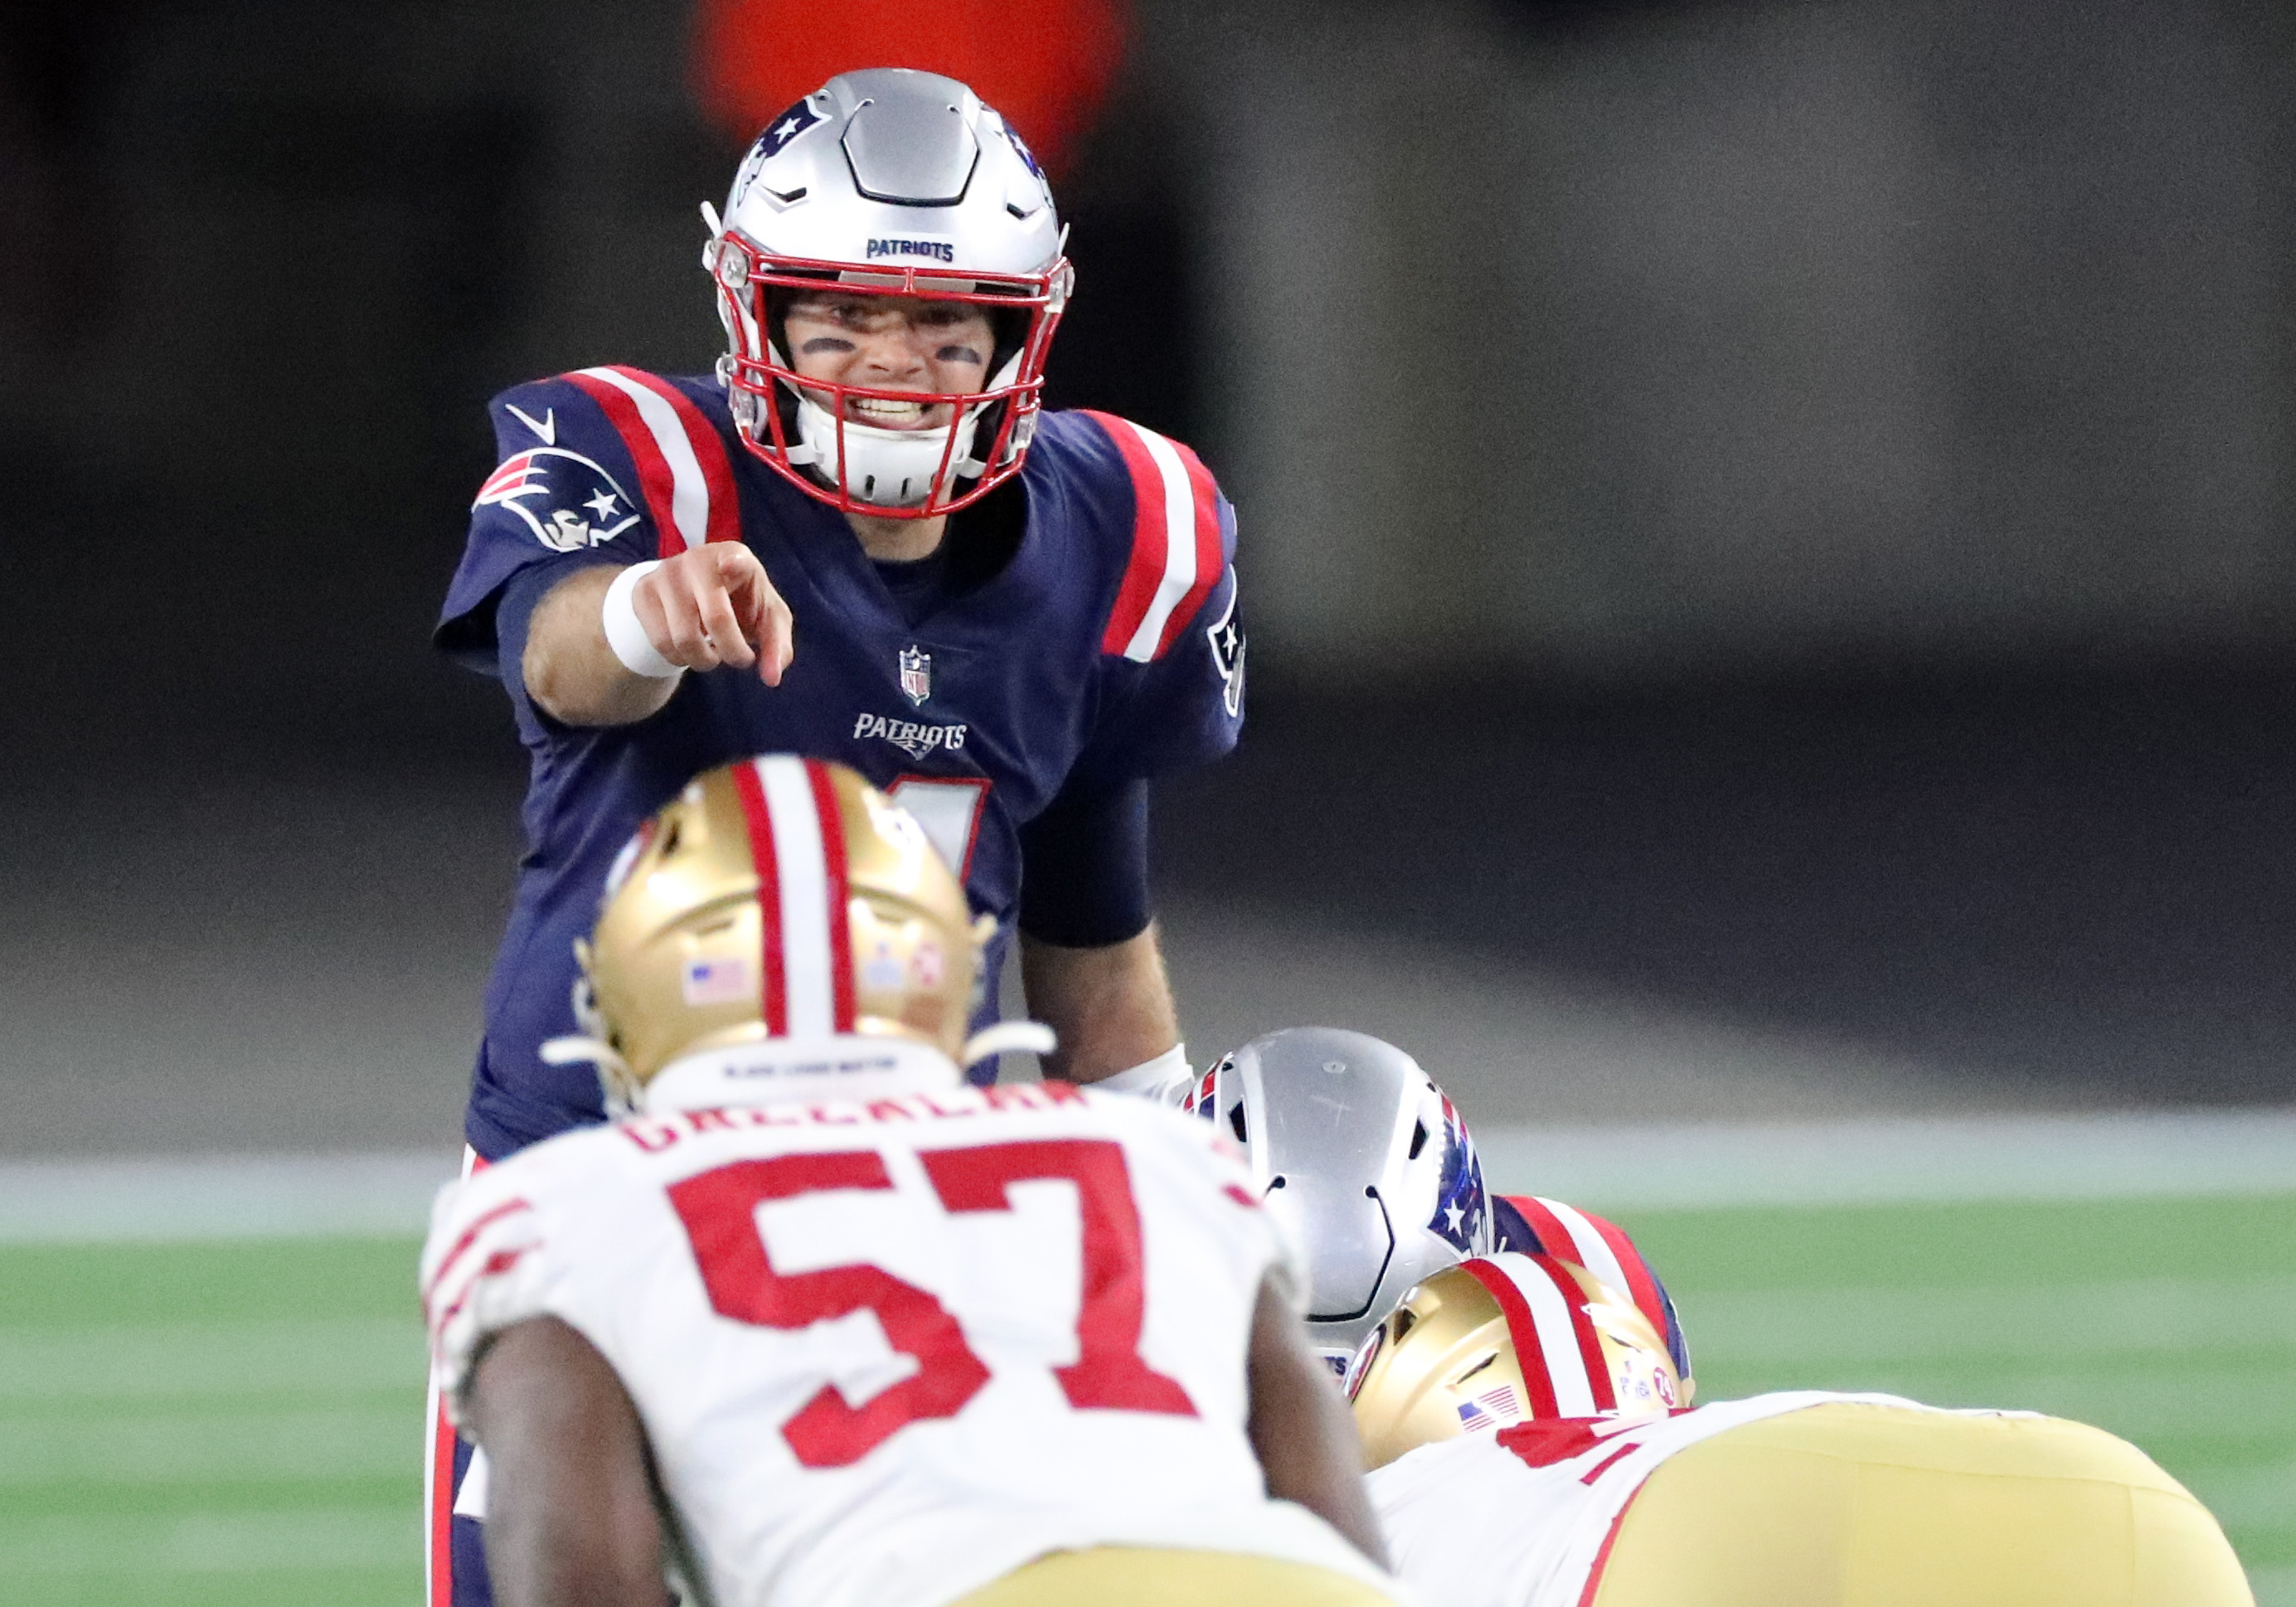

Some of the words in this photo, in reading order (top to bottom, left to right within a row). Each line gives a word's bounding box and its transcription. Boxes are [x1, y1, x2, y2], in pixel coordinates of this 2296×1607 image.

[866, 238, 954, 264] PATRIOTS
[852, 712, 968, 751] PATRIOTS
[667, 1138, 1202, 1469] 57
